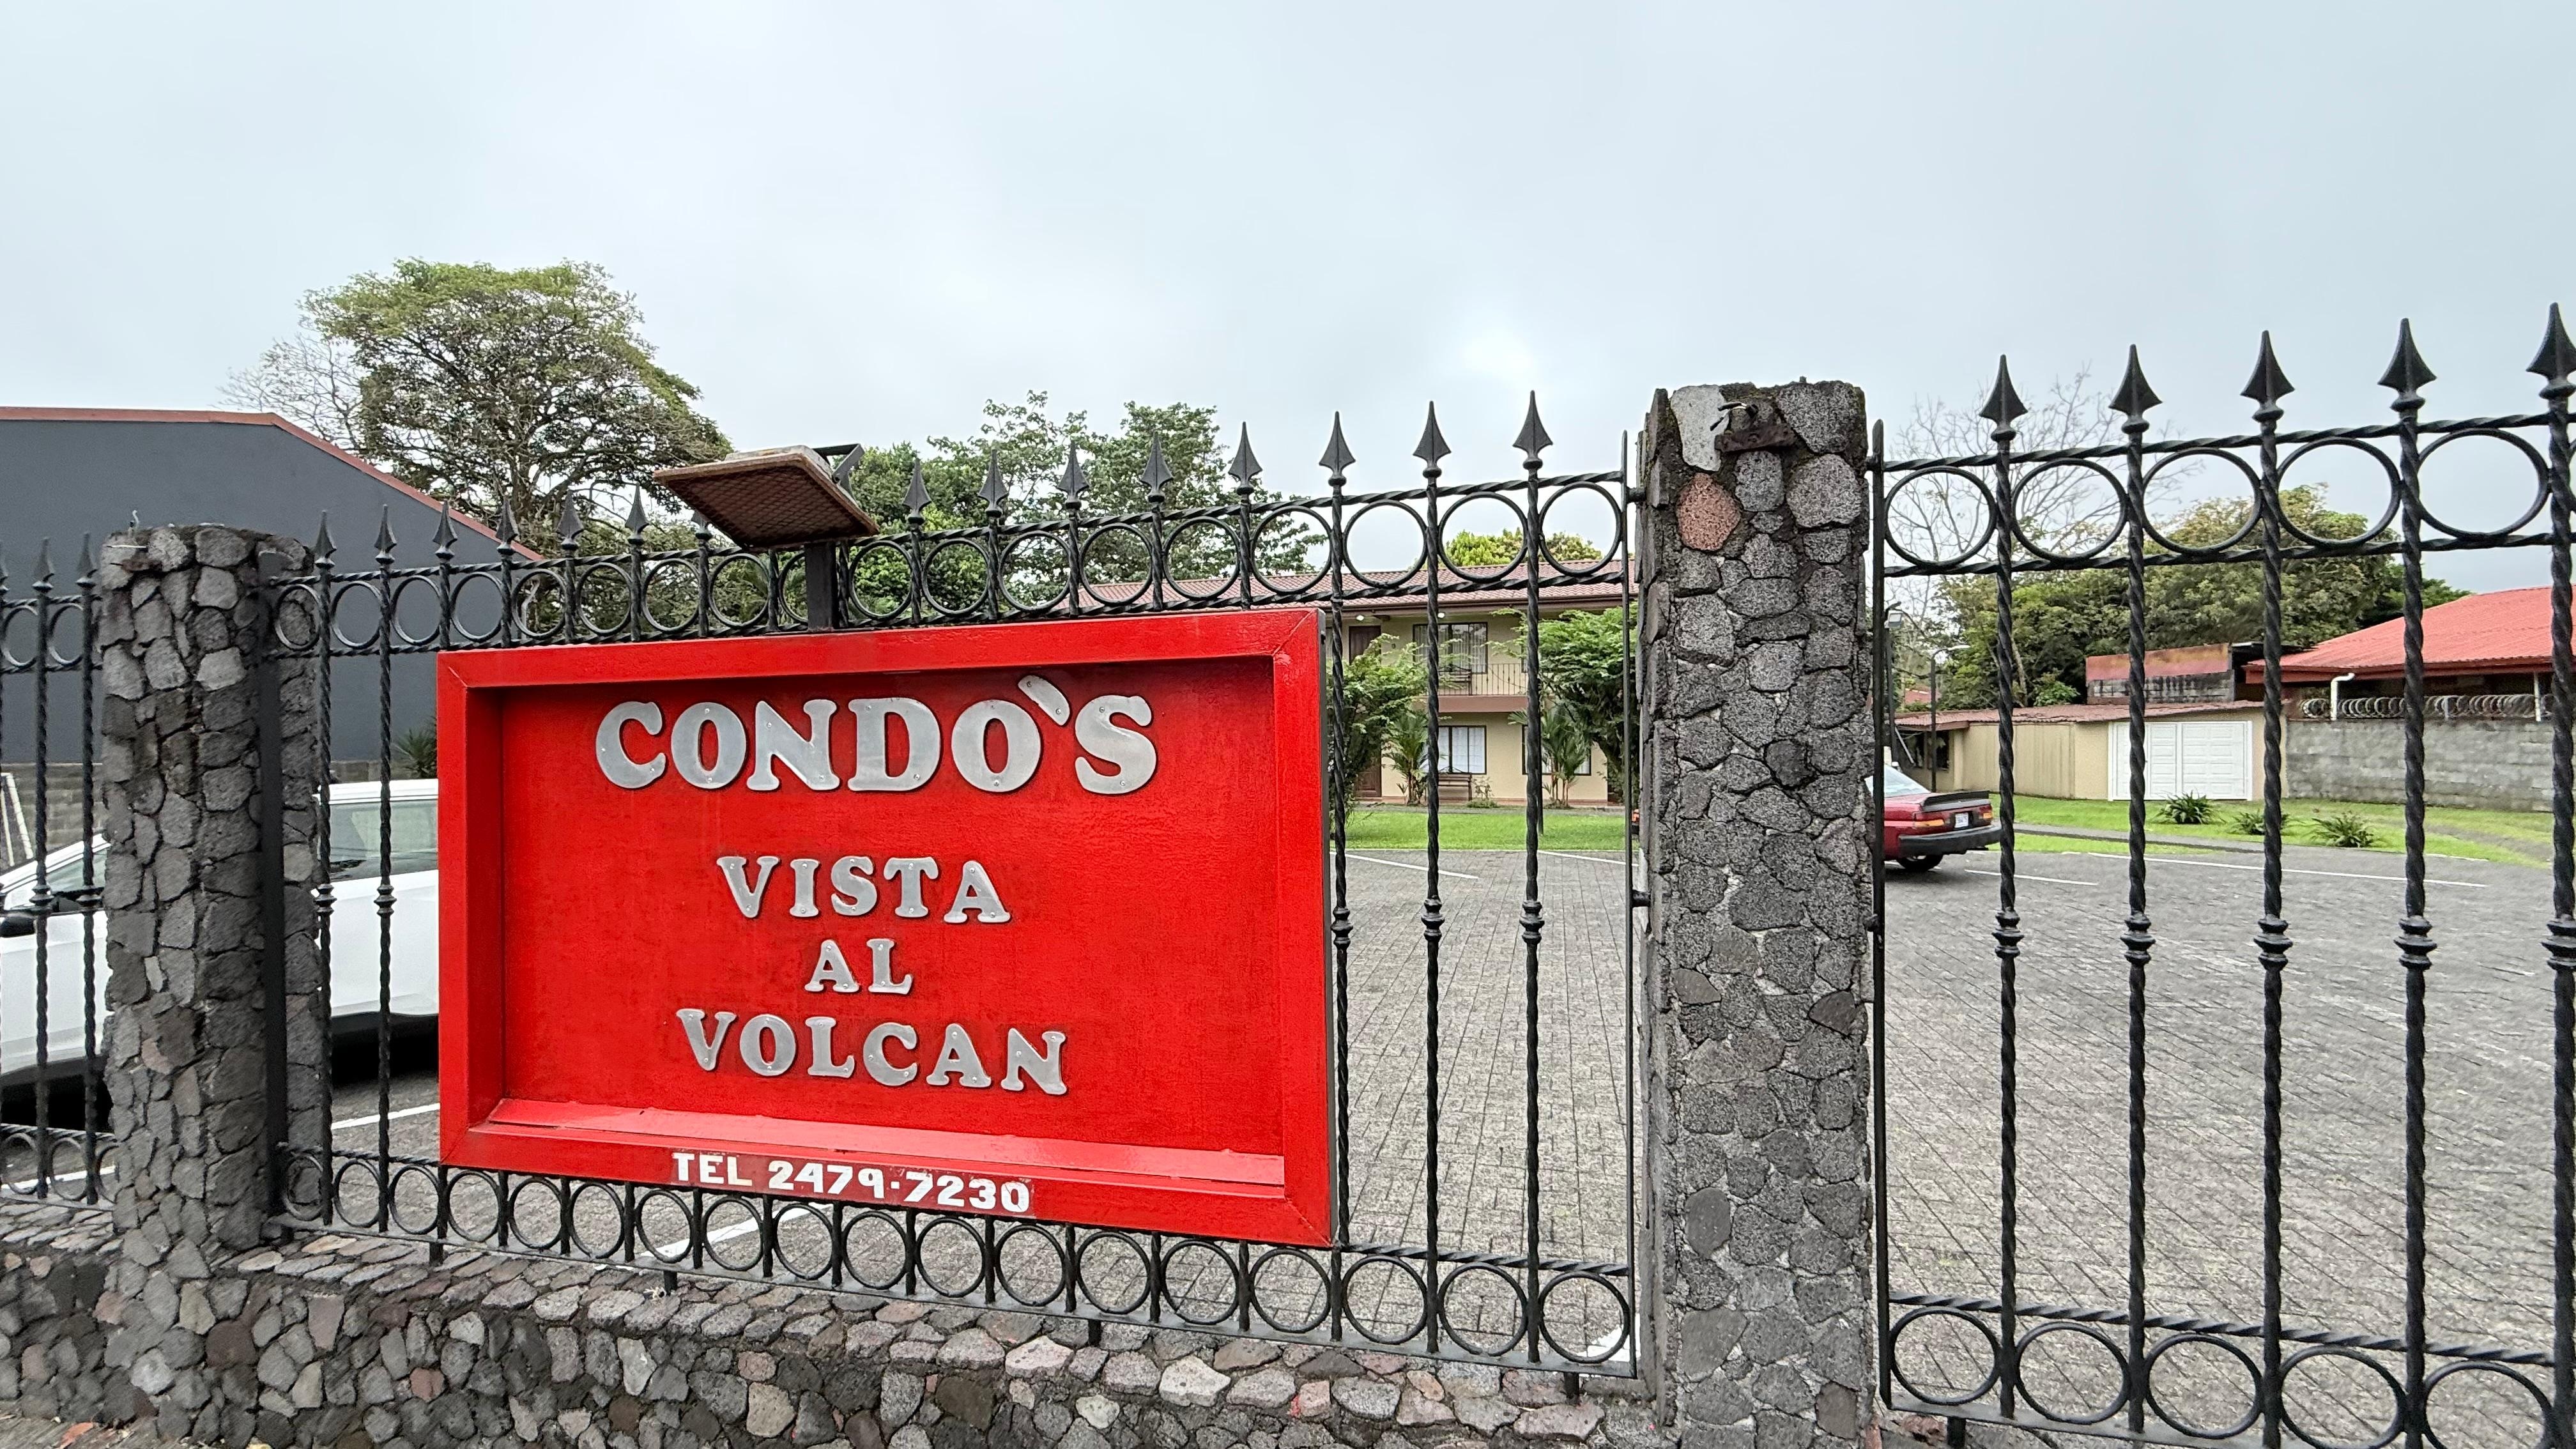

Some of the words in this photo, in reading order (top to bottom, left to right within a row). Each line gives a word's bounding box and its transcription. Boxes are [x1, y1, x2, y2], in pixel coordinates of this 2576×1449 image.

[716, 855, 1011, 924] VISTA
[804, 938, 912, 995] AL
[676, 1008, 1068, 1095] VOLCAN
[672, 1153, 753, 1186] TEL
